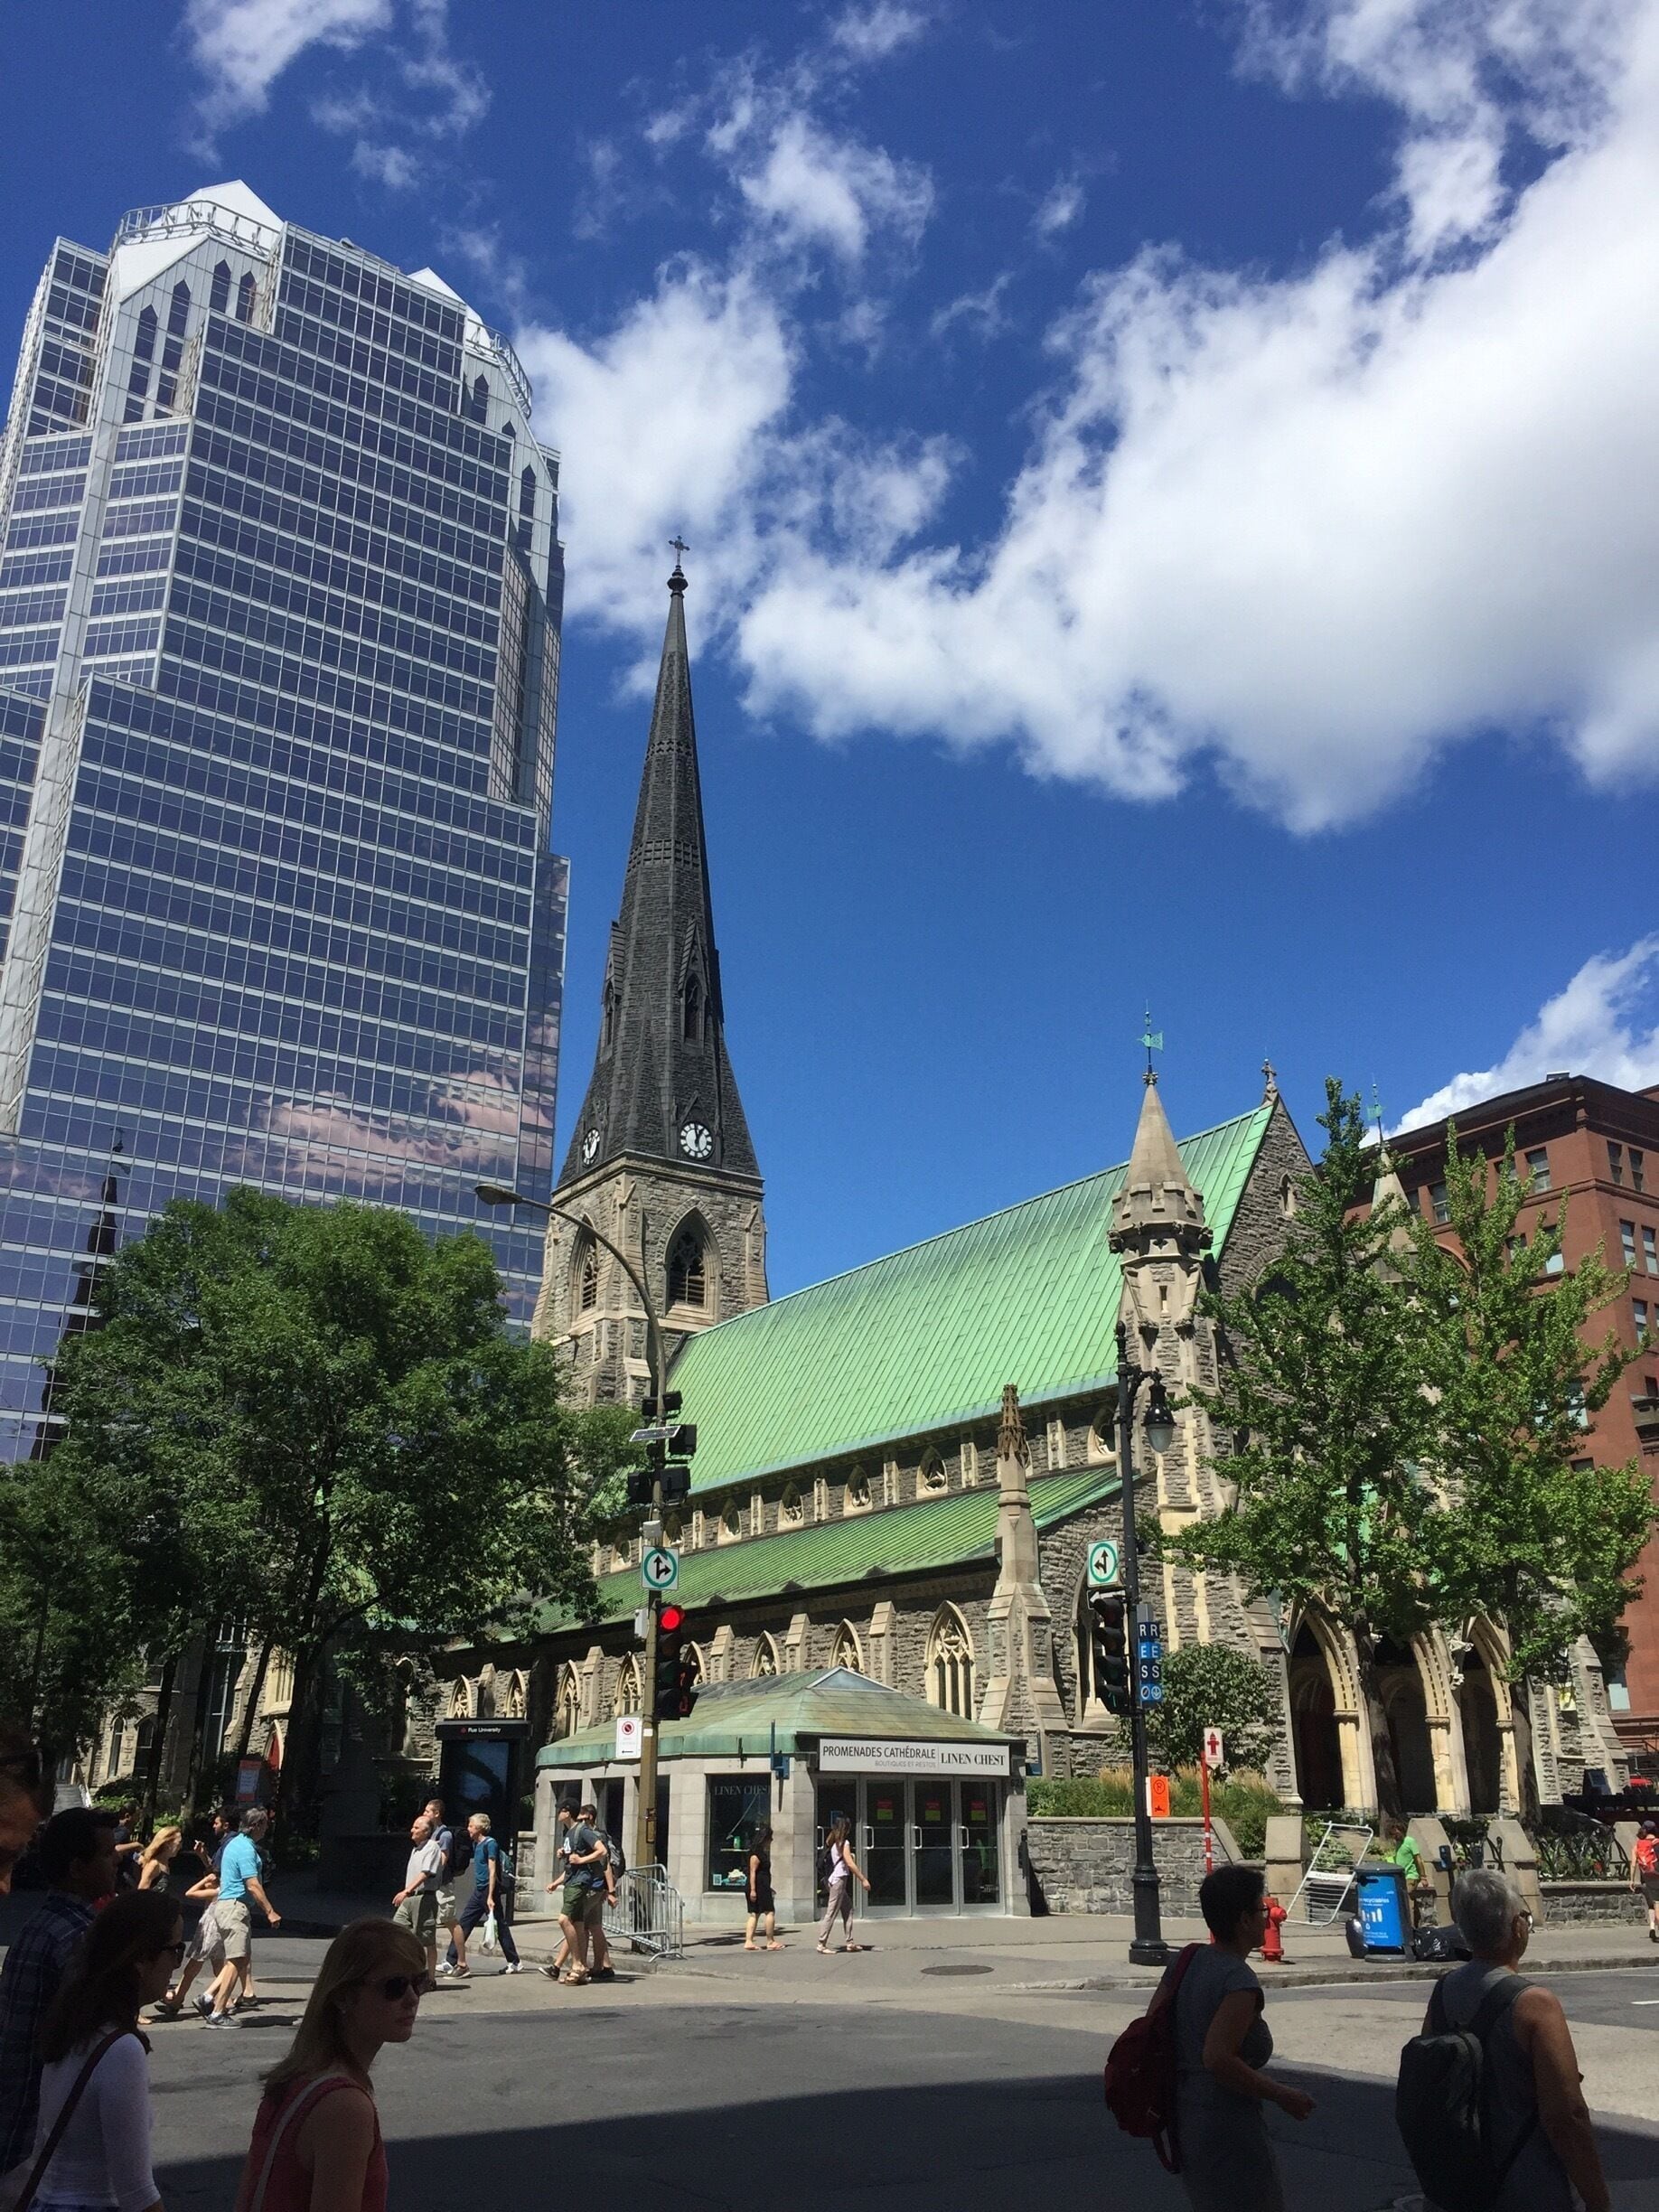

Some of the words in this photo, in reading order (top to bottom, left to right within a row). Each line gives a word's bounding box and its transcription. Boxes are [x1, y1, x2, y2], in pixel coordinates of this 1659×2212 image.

[823, 1746, 882, 1757] PROMENADES
[884, 1745, 936, 1759] CATHÉDRALE
[941, 1753, 971, 1765] LINEN
[974, 1754, 1005, 1766] CHEST
[715, 1786, 741, 1795] LINEN
